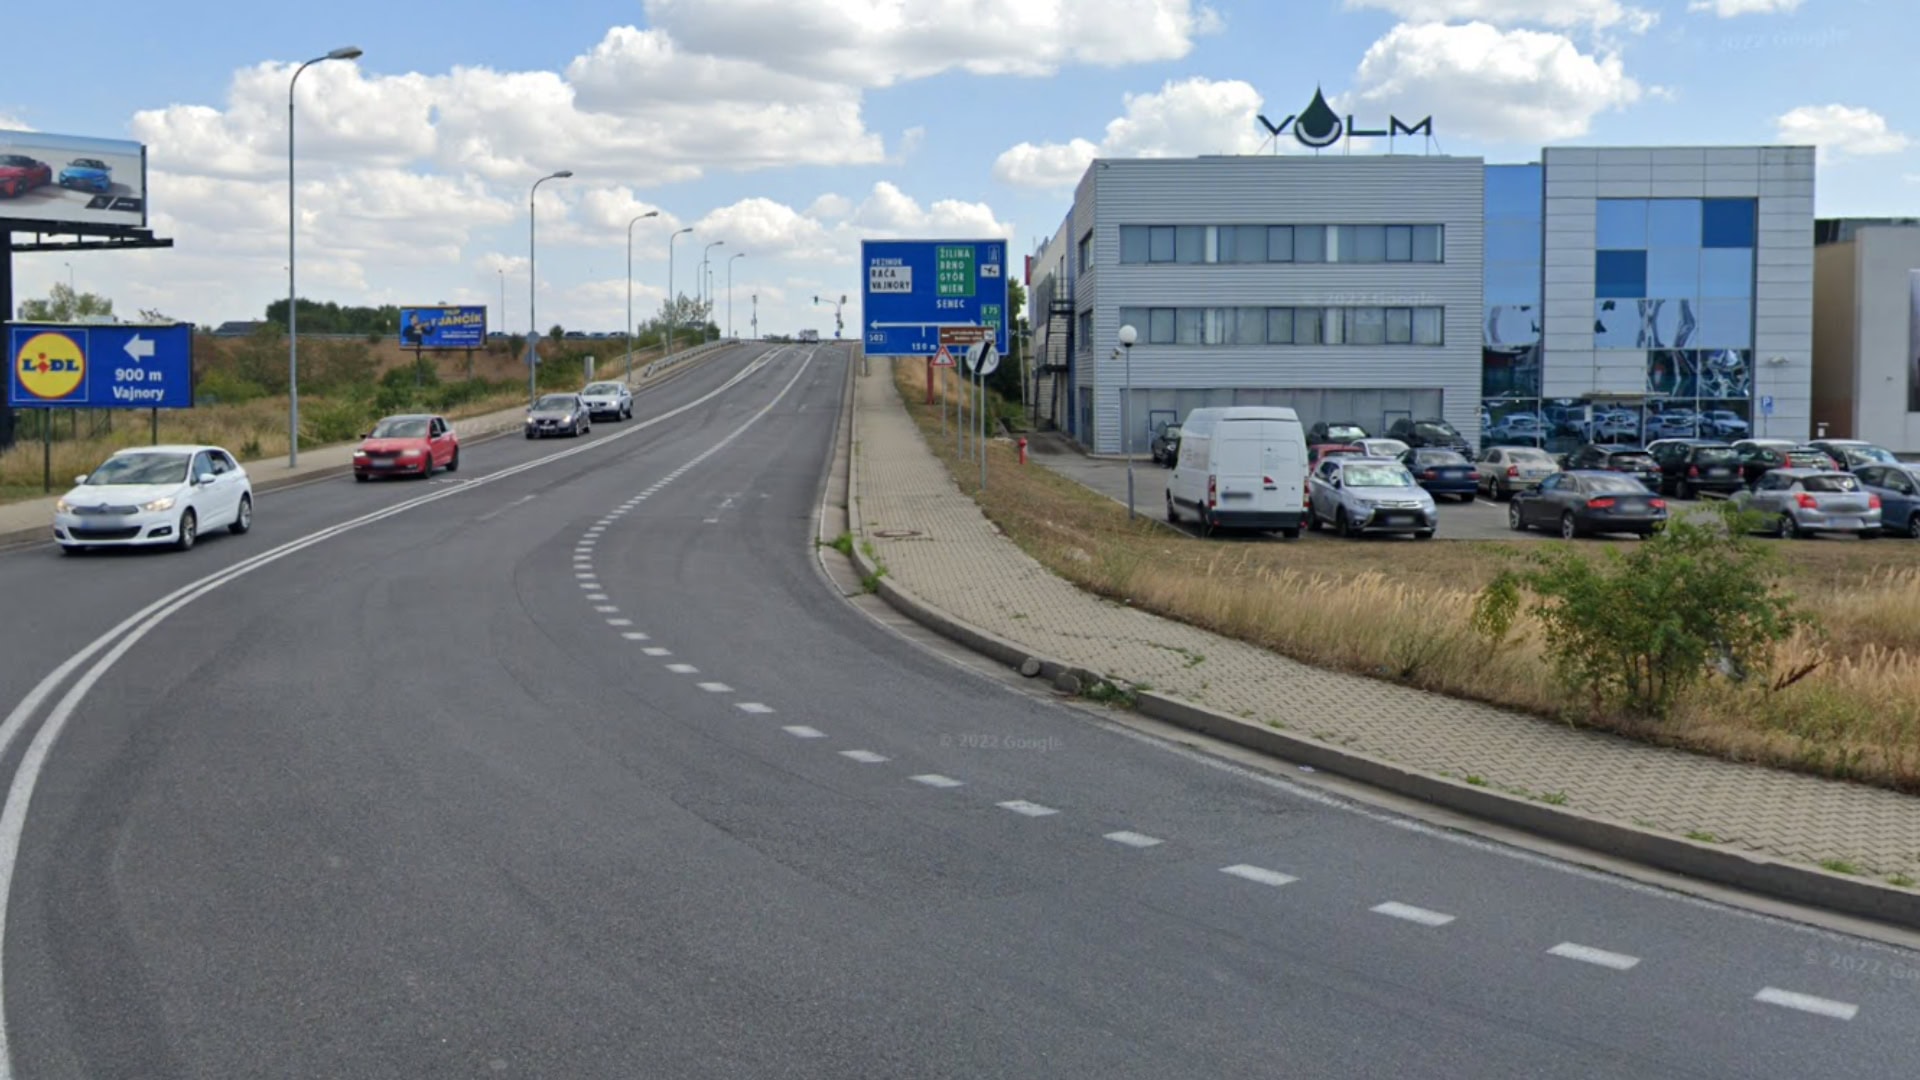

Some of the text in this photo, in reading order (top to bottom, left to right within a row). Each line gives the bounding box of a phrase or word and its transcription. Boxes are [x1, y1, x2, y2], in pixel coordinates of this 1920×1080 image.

[940, 247, 970, 258] ŽILINA
[940, 260, 965, 270] BRNO
[872, 281, 910, 290] VAJNORY
[940, 284, 964, 294] WIEN
[936, 299, 965, 309] SENEC
[22, 353, 79, 374] LIDL
[115, 368, 162, 382] 900 m
[112, 386, 164, 401] Vajnory
